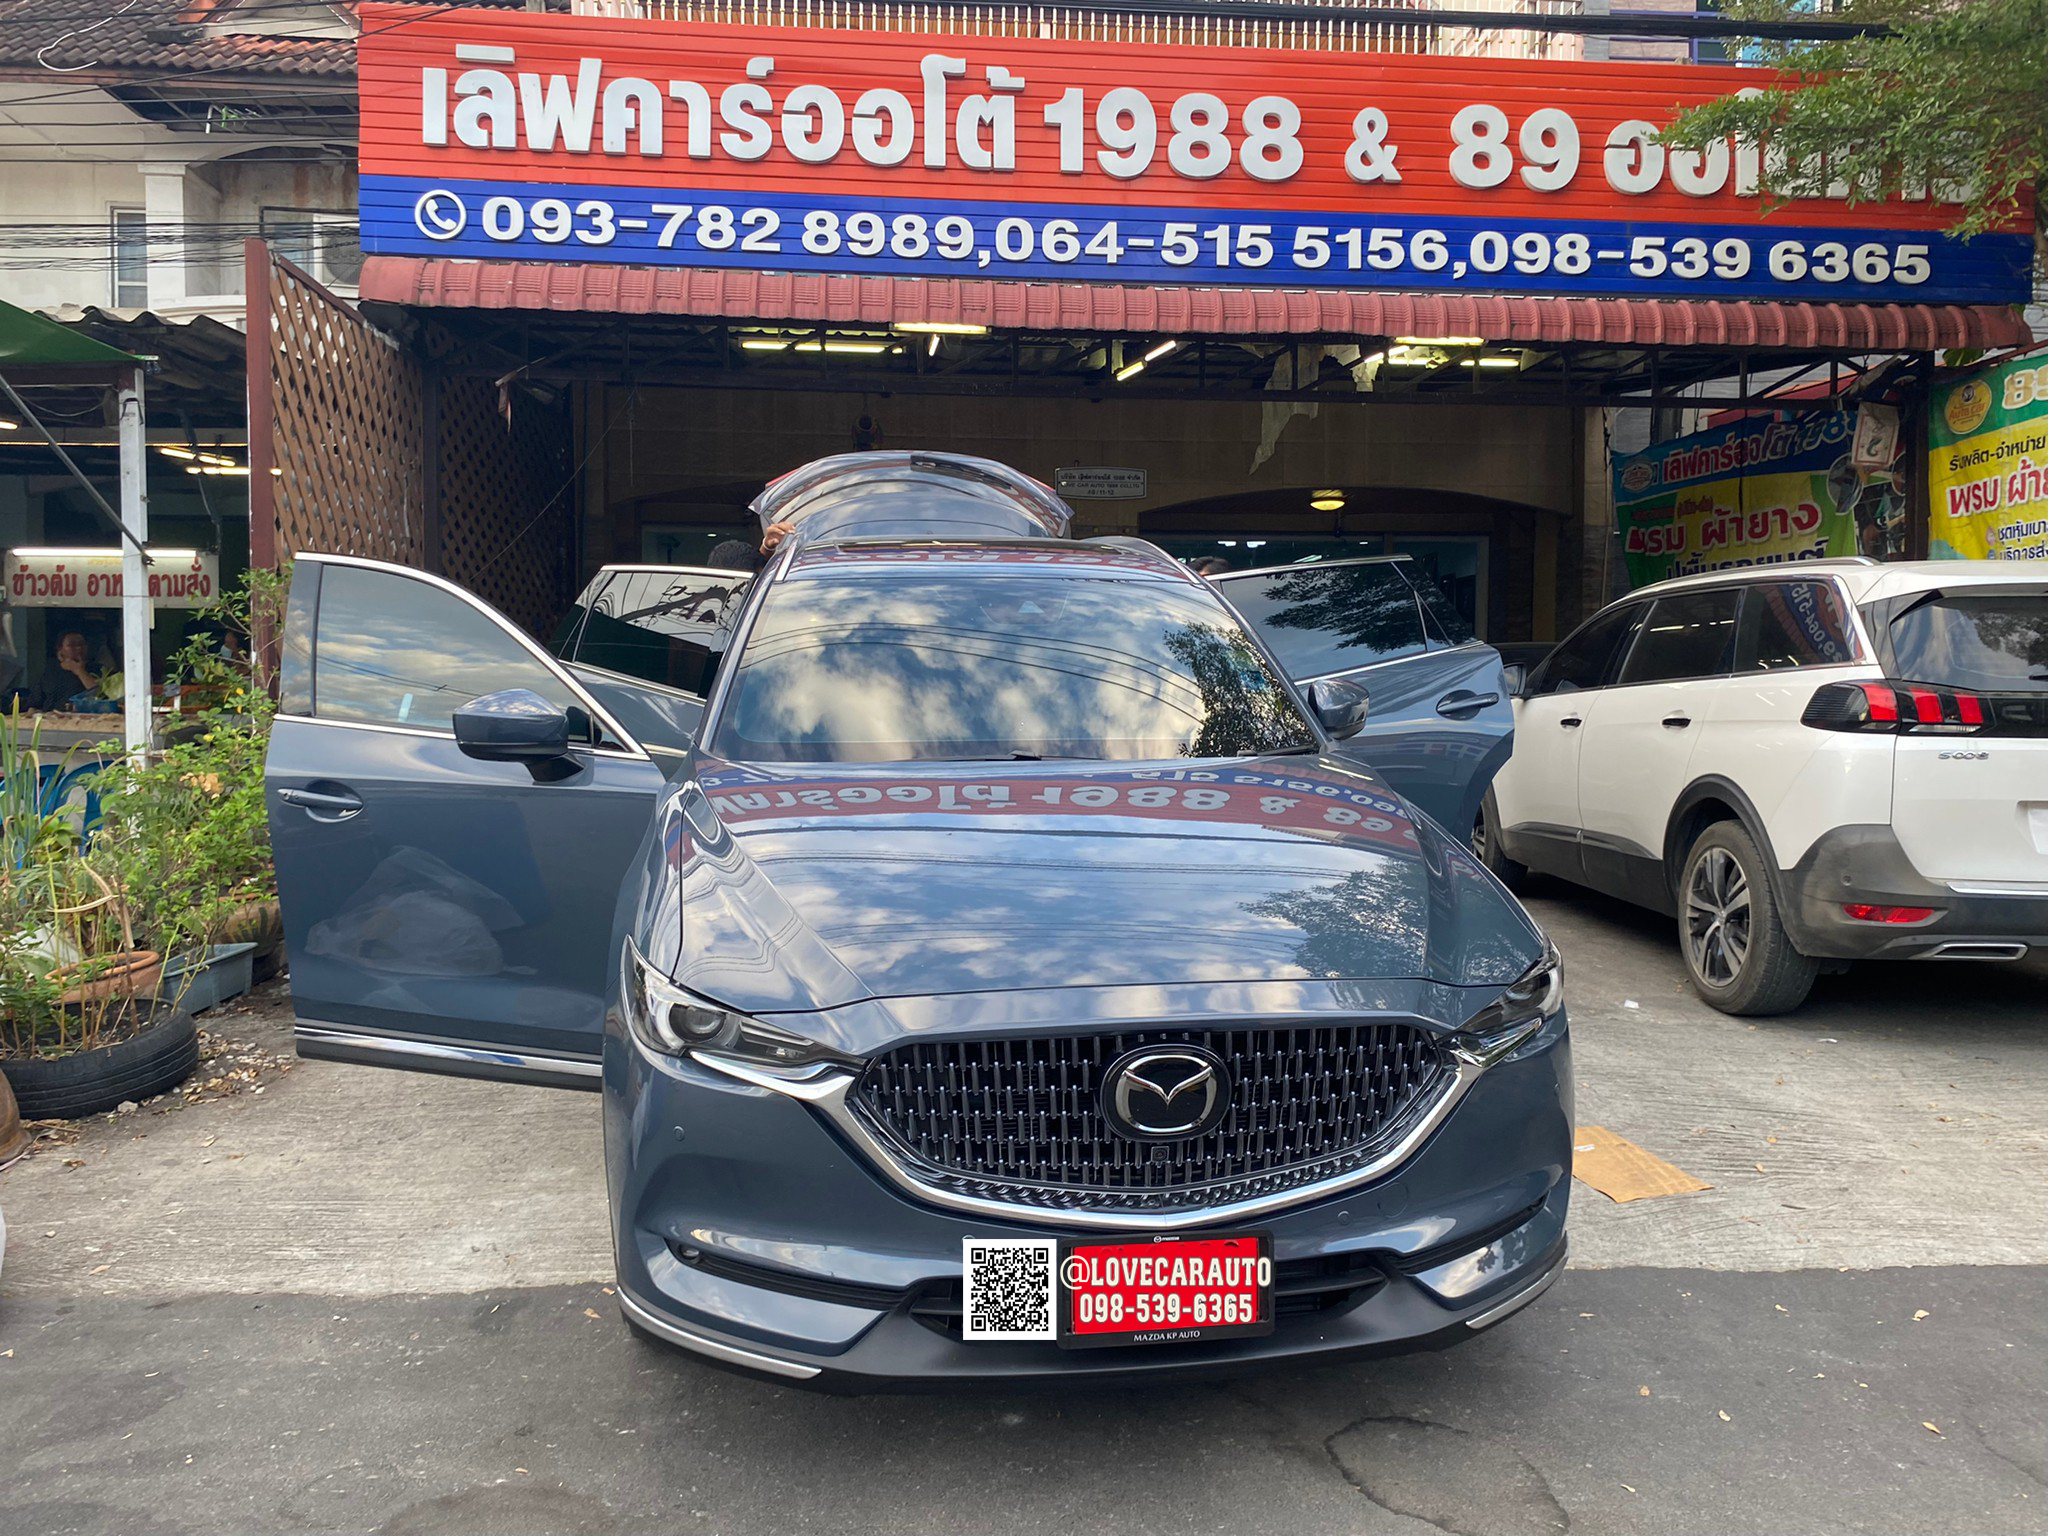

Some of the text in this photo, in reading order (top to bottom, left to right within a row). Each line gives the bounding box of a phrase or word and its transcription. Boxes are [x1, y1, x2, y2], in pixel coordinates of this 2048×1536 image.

[421, 43, 1026, 173] เลิฟคาร์ออโต้
[1043, 86, 1304, 184] 1988
[1343, 106, 1403, 185] &
[1448, 103, 1581, 194] 89
[482, 194, 782, 254] 093-782
[1766, 240, 1931, 285] 6365
[1948, 458, 2048, 516] พรม ผ้า
[1701, 500, 1822, 551] ผ้ายาง
[1998, 520, 2048, 545] ชุดหุ้มเบา
[12, 564, 78, 597] ข้าวต้ม
[1133, 1330, 1201, 1342] MAZDA KP AUTO
